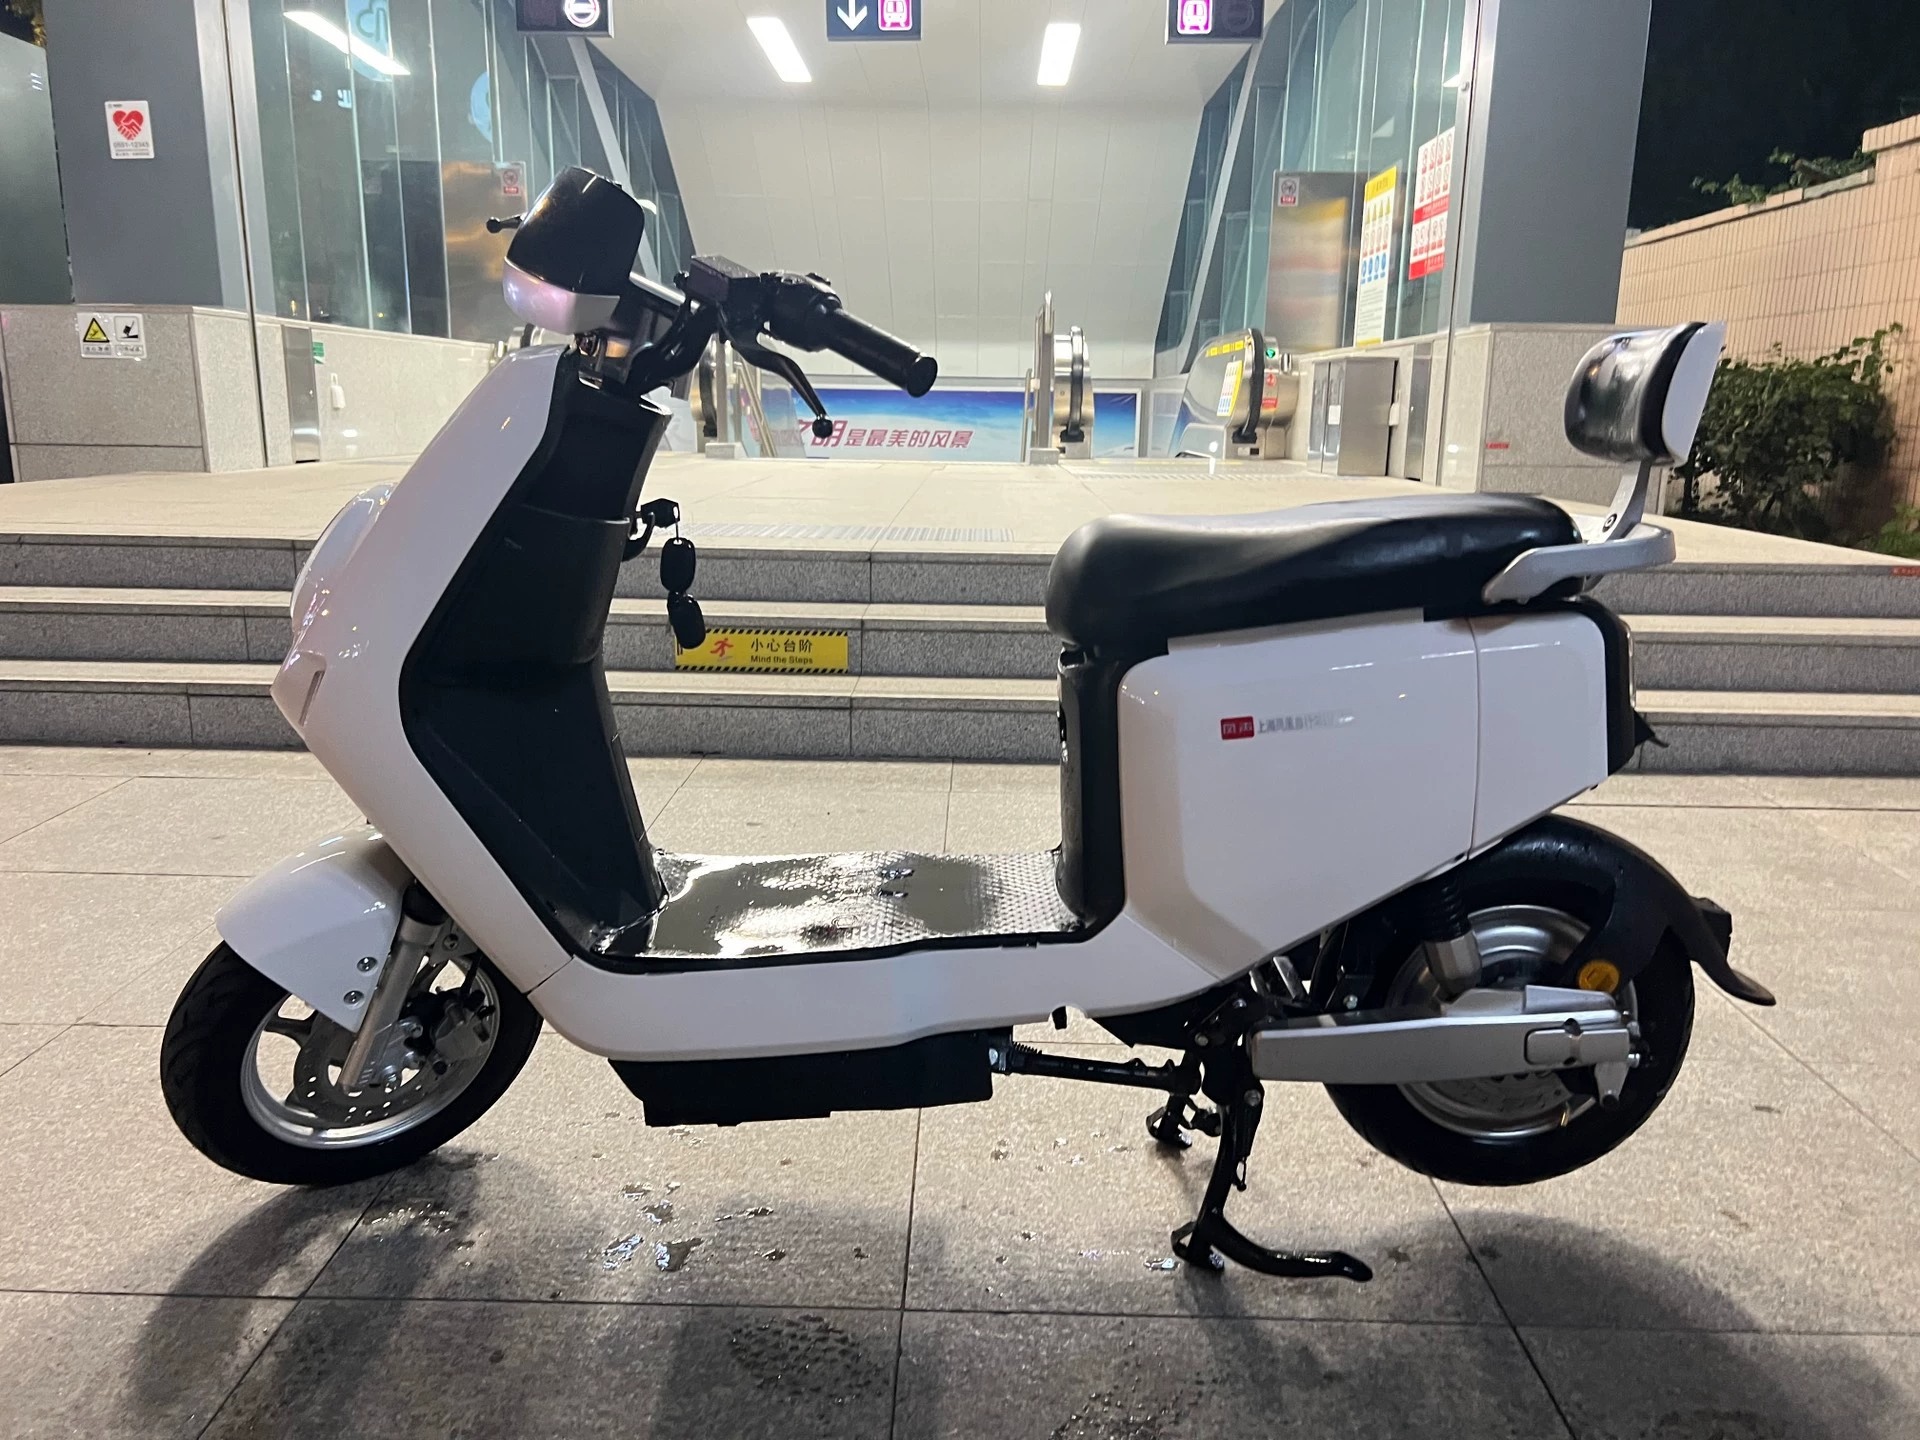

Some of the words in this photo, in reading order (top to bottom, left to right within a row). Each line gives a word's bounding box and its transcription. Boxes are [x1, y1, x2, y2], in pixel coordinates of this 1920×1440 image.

[751, 638, 812, 653] 小心台阶
[751, 655, 771, 663] Mind
[789, 656, 813, 664] Steps
